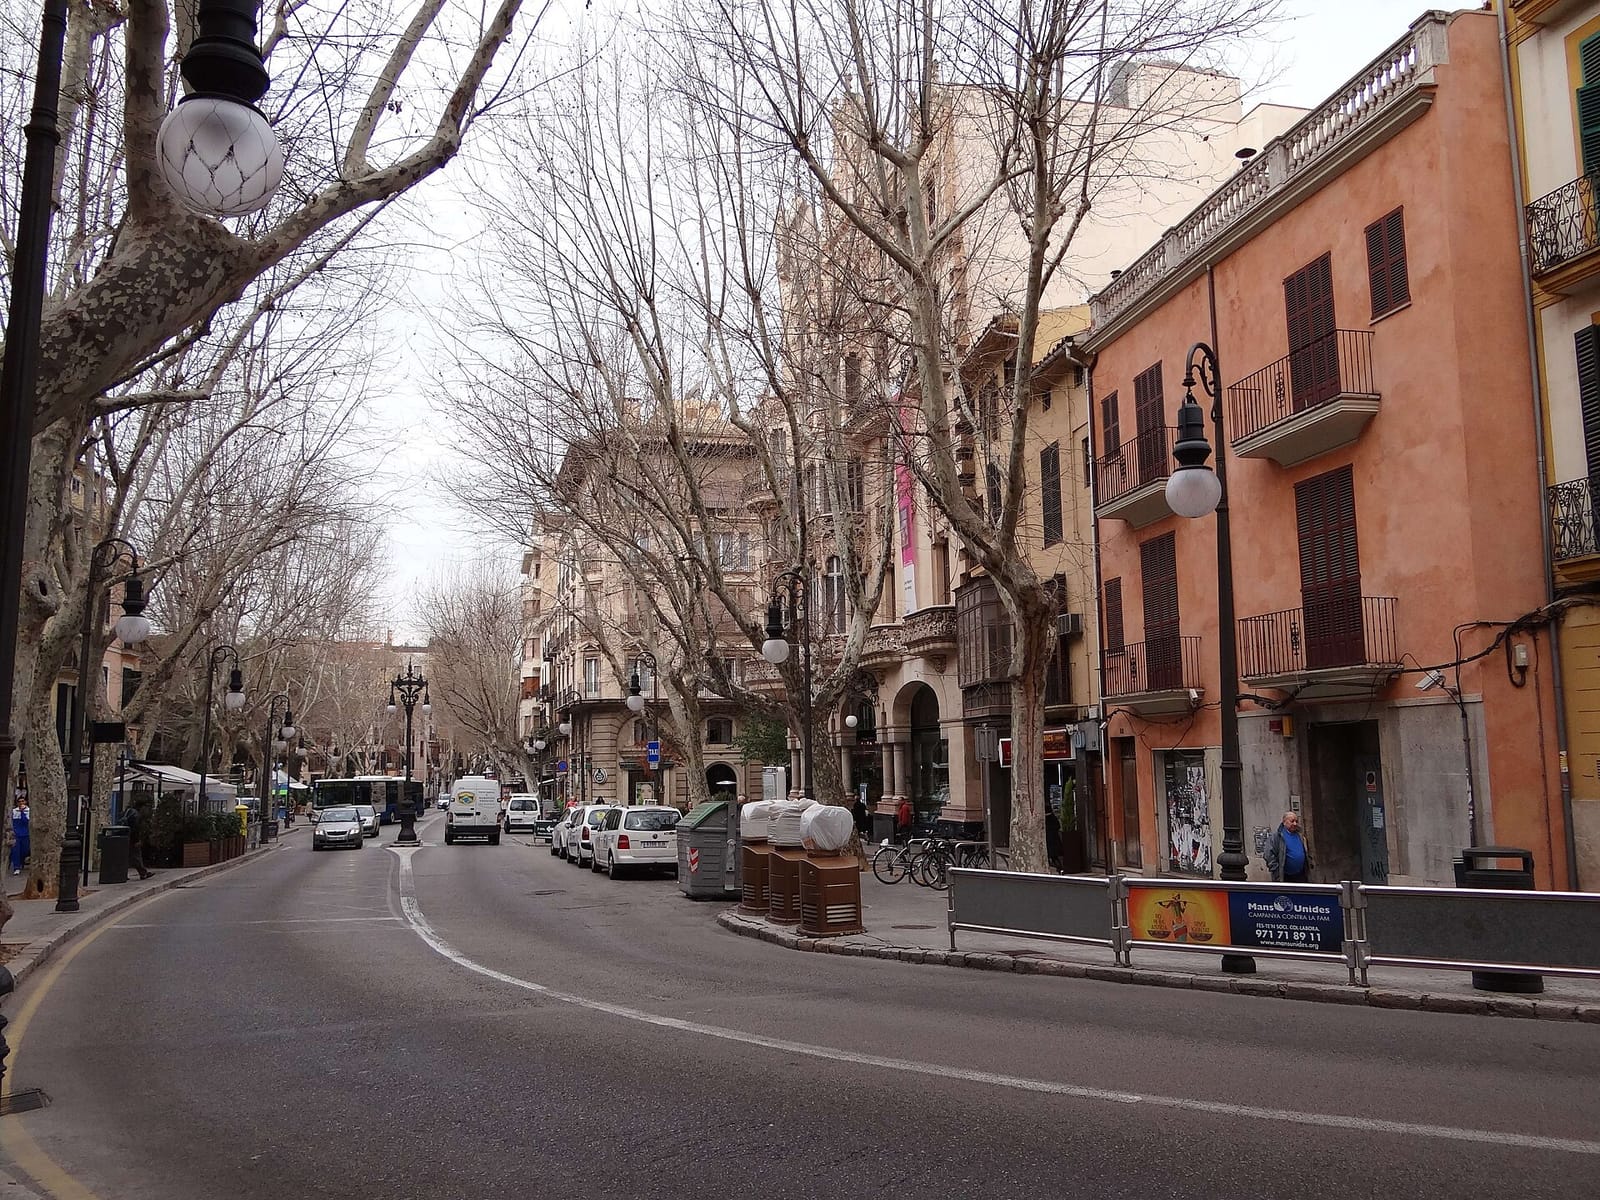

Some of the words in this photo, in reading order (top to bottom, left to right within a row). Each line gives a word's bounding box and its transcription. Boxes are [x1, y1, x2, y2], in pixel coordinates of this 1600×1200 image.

[1247, 902, 1274, 911] Mans
[1294, 904, 1330, 914] Unides
[1255, 929, 1273, 939] 971
[1277, 930, 1289, 940] 71
[1293, 931, 1306, 941] 89
[1309, 932, 1321, 942] 11
[1260, 940, 1319, 950] www.mansunides.org
